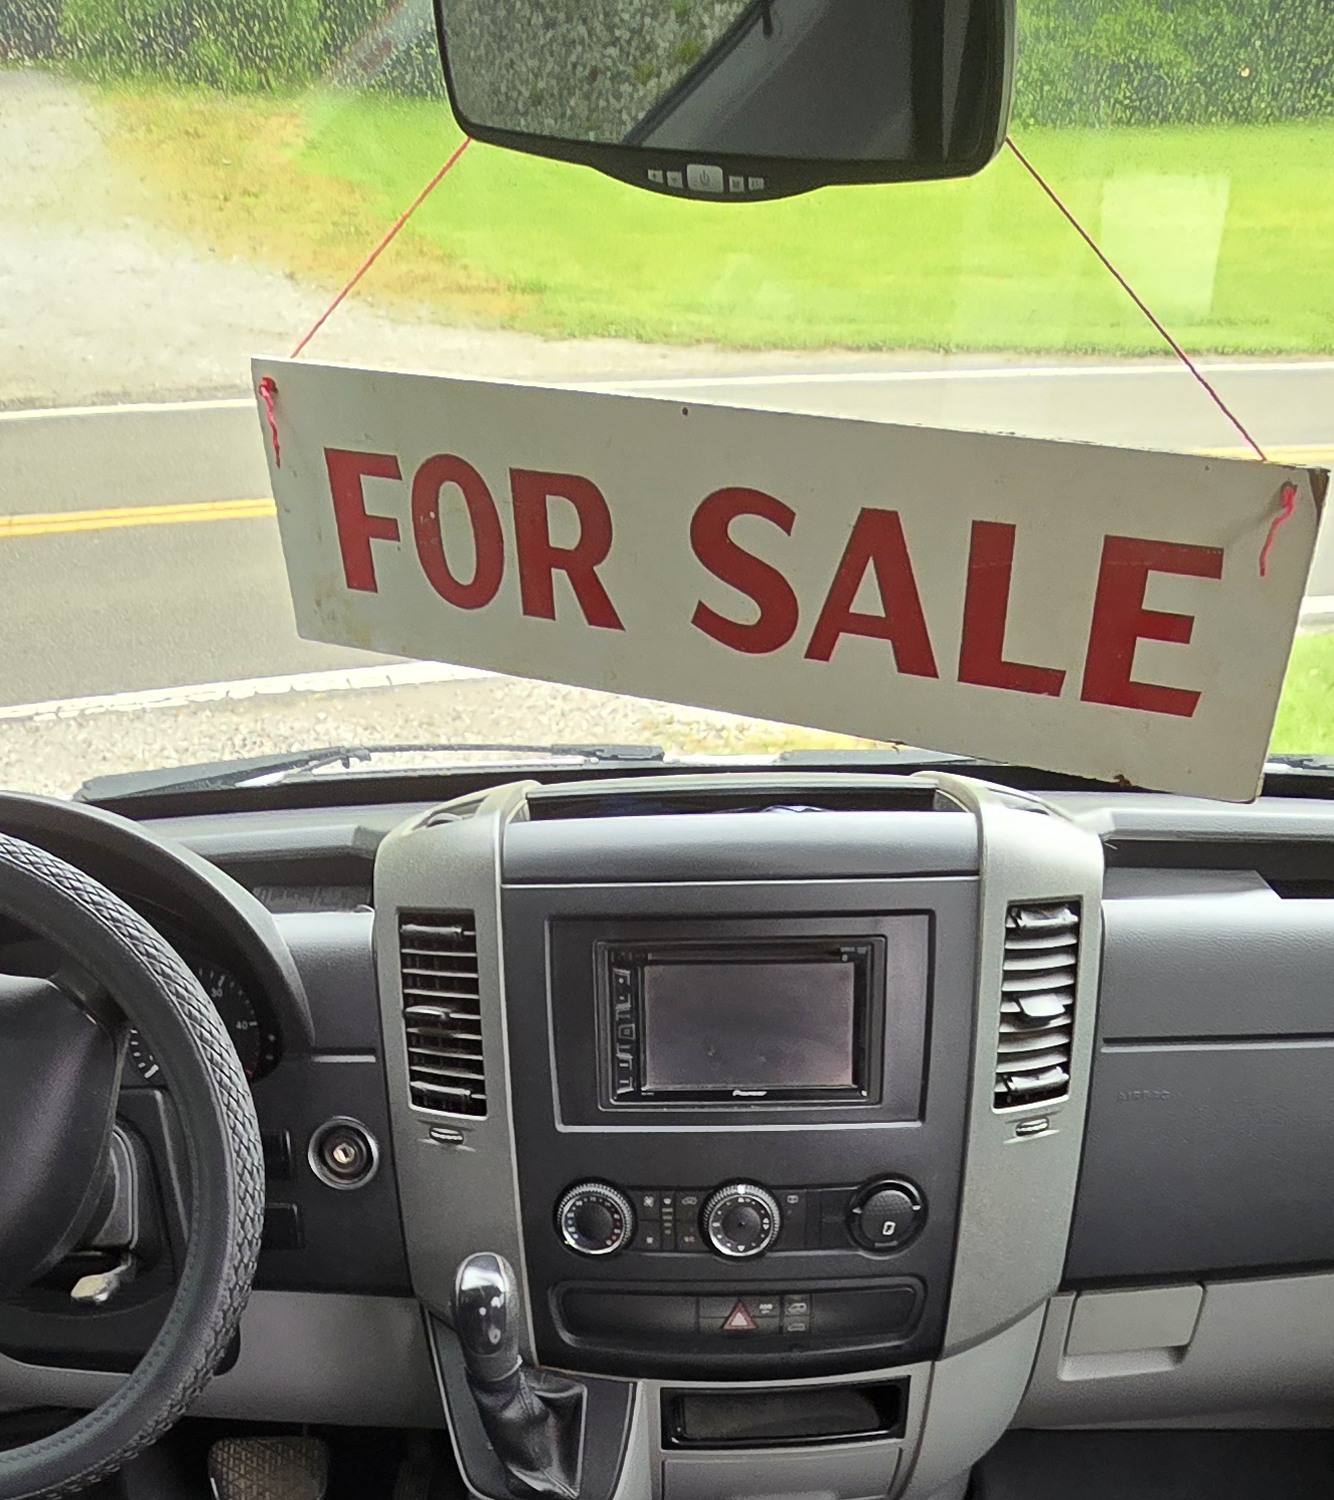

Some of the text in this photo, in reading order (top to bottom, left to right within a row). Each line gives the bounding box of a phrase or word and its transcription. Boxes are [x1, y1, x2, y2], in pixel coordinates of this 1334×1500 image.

[323, 446, 1225, 718] FOR SALE
[211, 987, 223, 998] 30
[236, 1020, 248, 1030] 40
